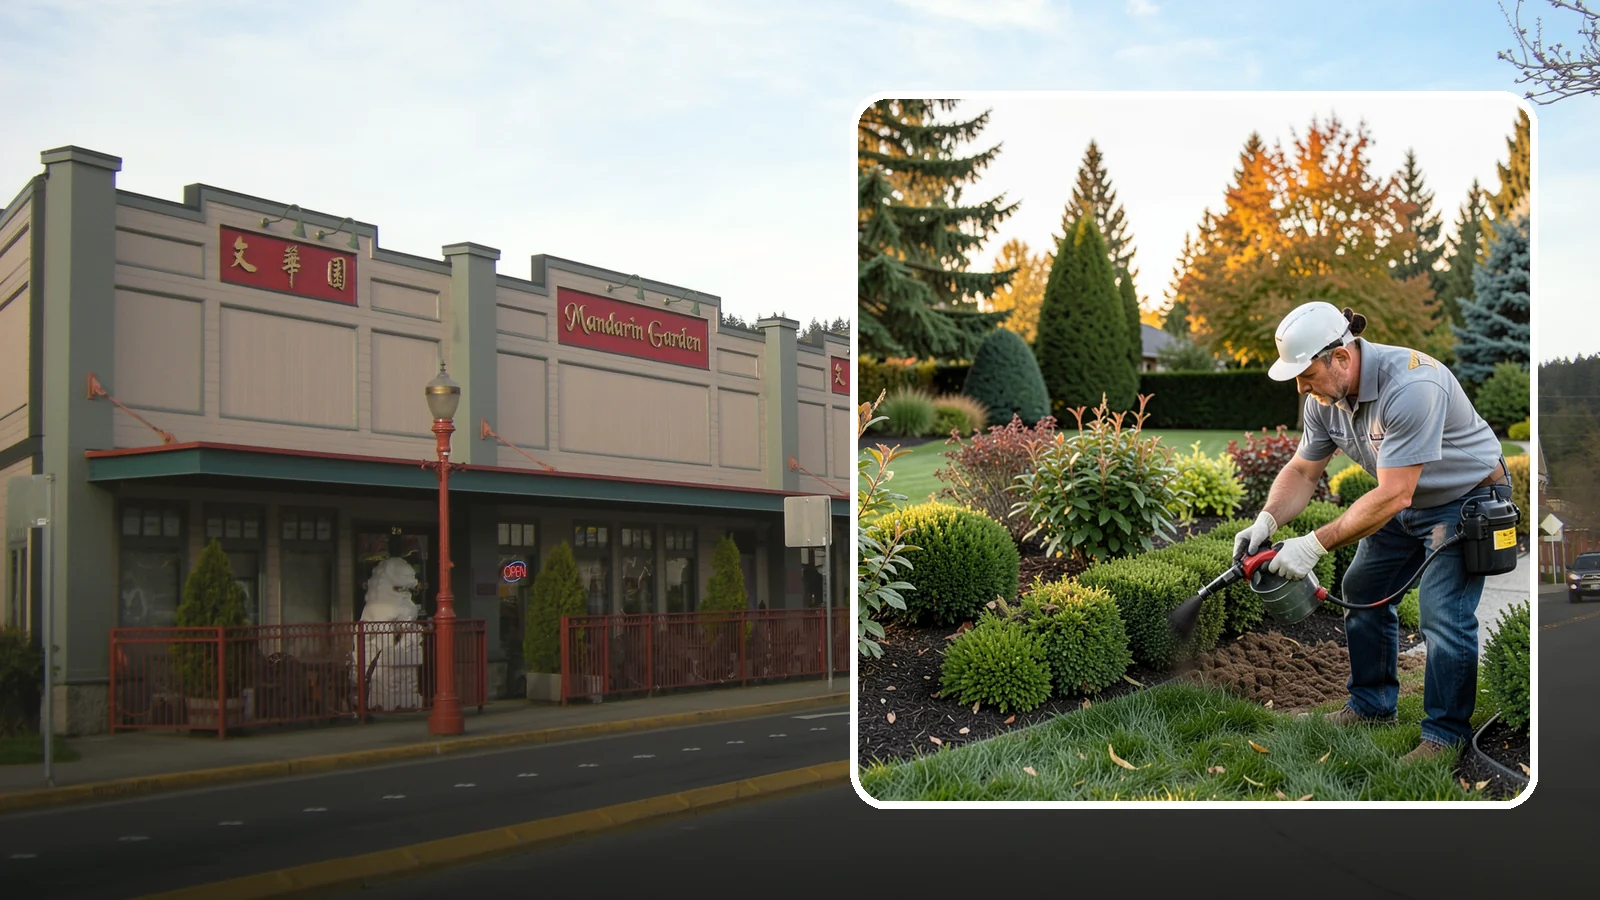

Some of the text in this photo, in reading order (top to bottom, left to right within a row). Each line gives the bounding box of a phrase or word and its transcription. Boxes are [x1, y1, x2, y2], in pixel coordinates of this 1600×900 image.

[231, 235, 346, 291] 文華園
[564, 302, 701, 351] Mandarin Garden
[834, 363, 846, 386] 文
[503, 565, 527, 578] OPEN
